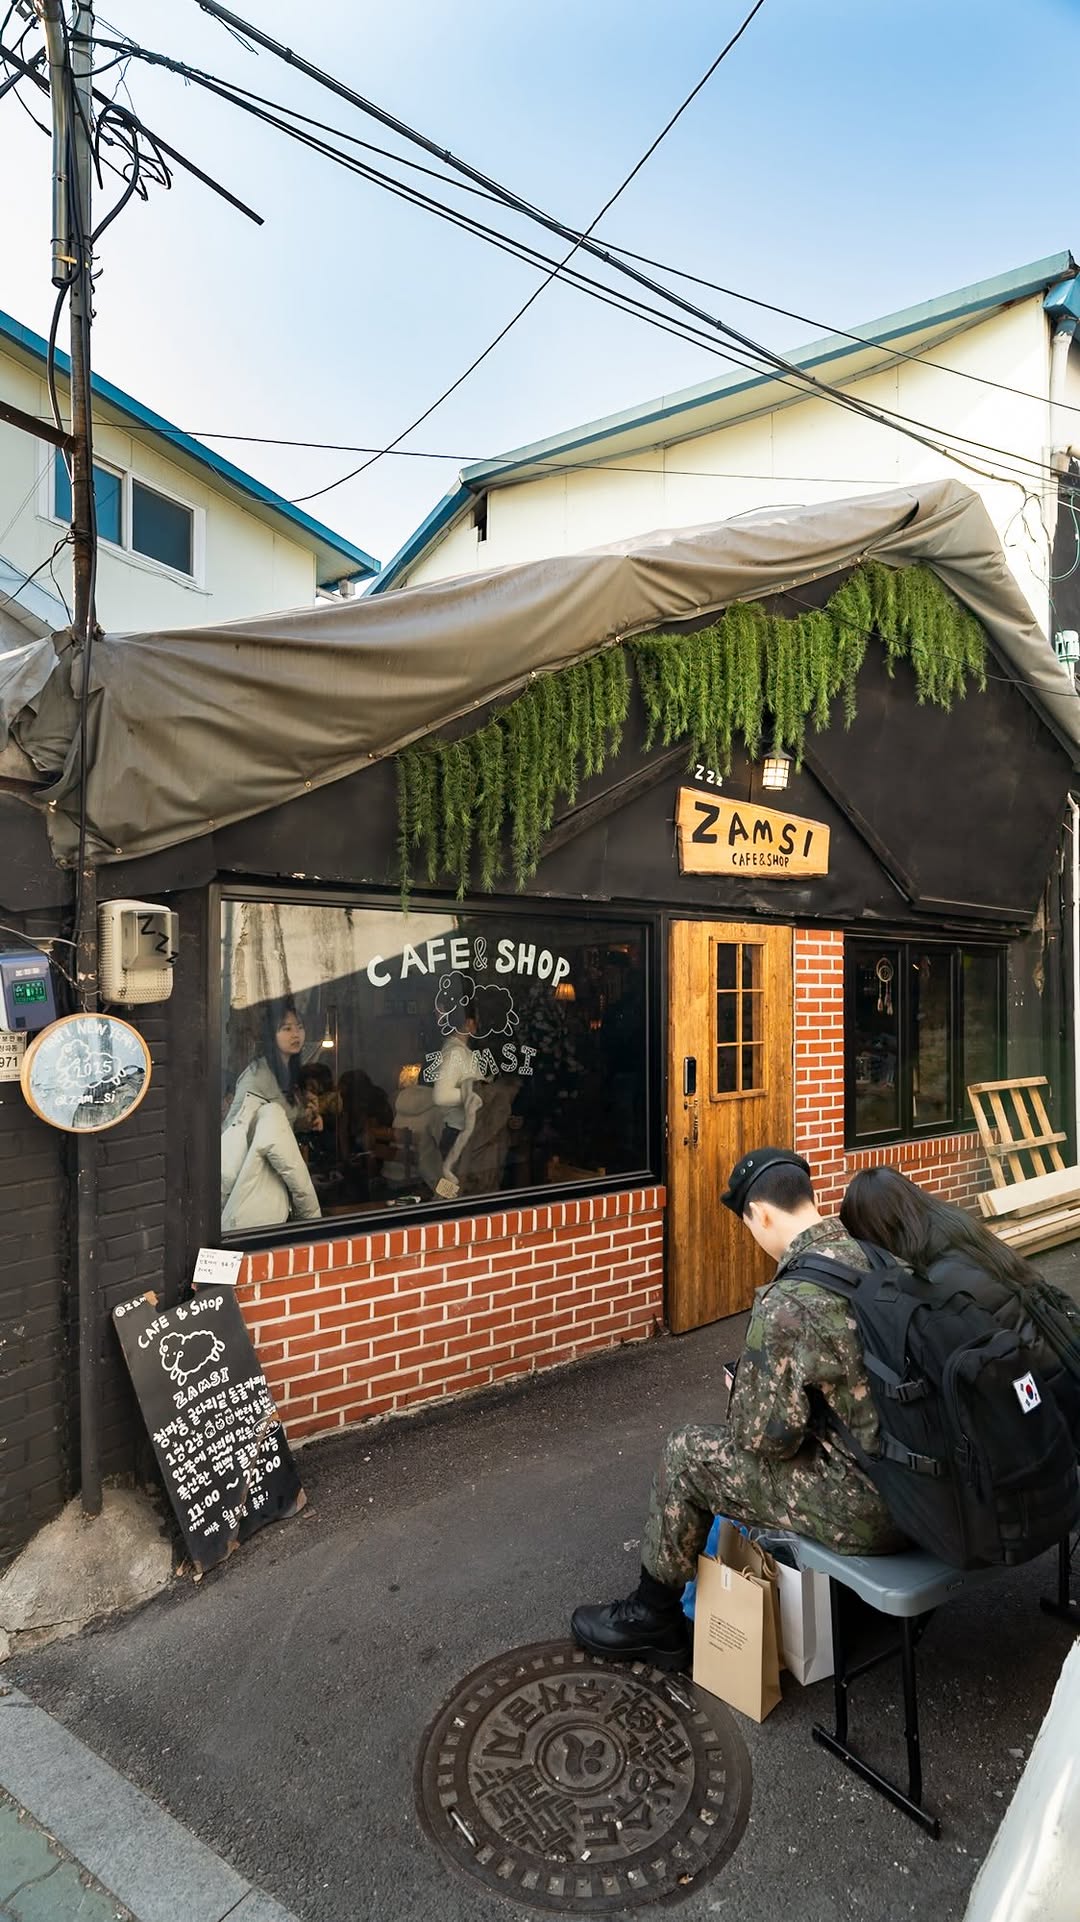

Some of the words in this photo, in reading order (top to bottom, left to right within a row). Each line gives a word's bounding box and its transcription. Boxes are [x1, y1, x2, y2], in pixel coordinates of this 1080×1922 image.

[692, 801, 813, 857] ZAMSI
[732, 852, 790, 867] CAFE&SHOP
[77, 1021, 108, 1036] NEW
[138, 1315, 170, 1348] CAFE
[176, 1308, 188, 1321] &
[190, 1296, 224, 1316] SHOP
[173, 1367, 230, 1409] ZAMSI
[153, 1416, 189, 1448] 청파동
[228, 1375, 267, 1404] 동굴카페
[187, 1489, 220, 1522] 11:00
[188, 1517, 205, 1532] OPEN
